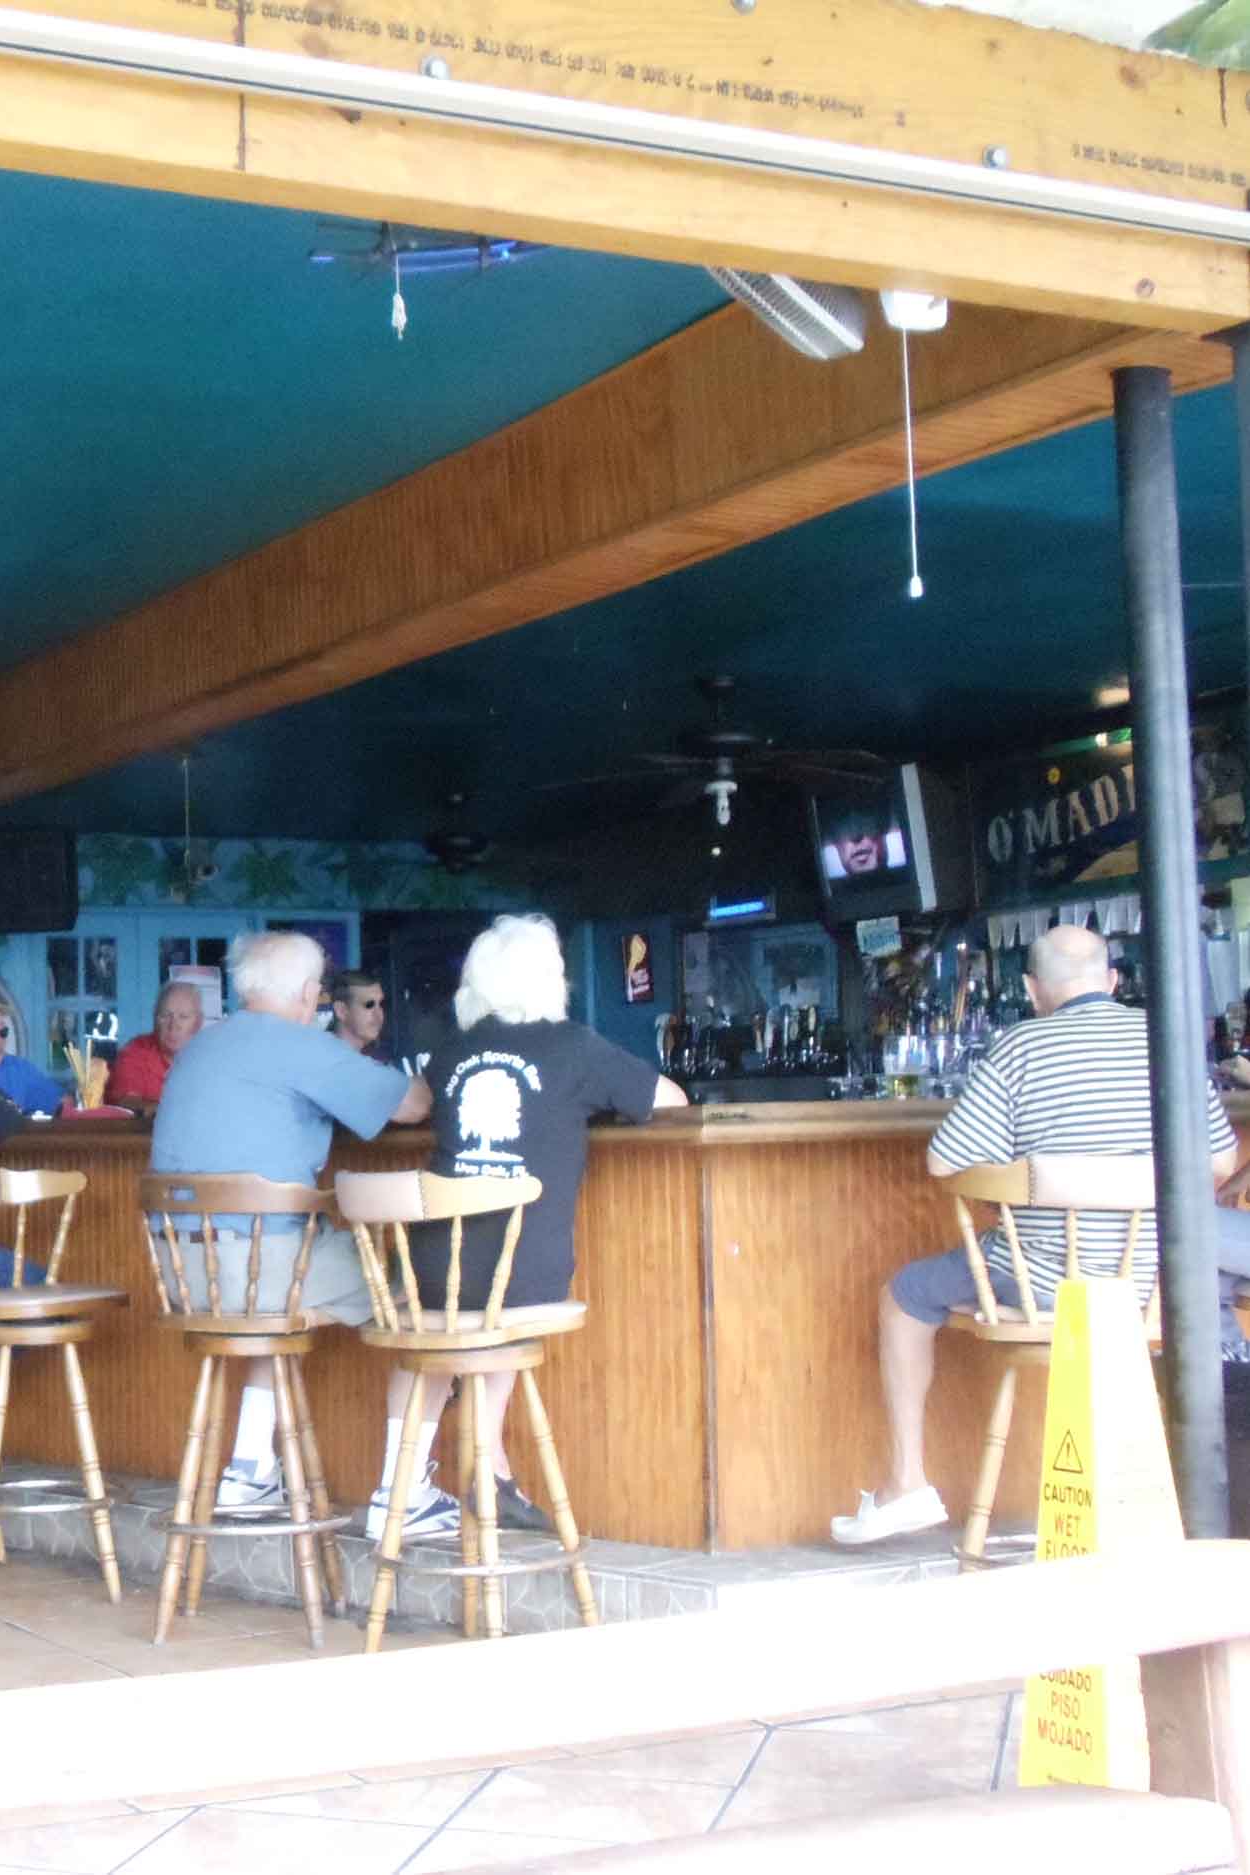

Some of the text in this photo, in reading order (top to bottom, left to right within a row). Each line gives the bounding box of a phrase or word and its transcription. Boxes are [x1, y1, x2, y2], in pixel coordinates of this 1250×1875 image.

[1044, 1482, 1092, 1509] CAUTION
[1054, 1512, 1081, 1538] WET
[1051, 1690, 1081, 1721] PISO
[1037, 1717, 1093, 1756] MOJADO
